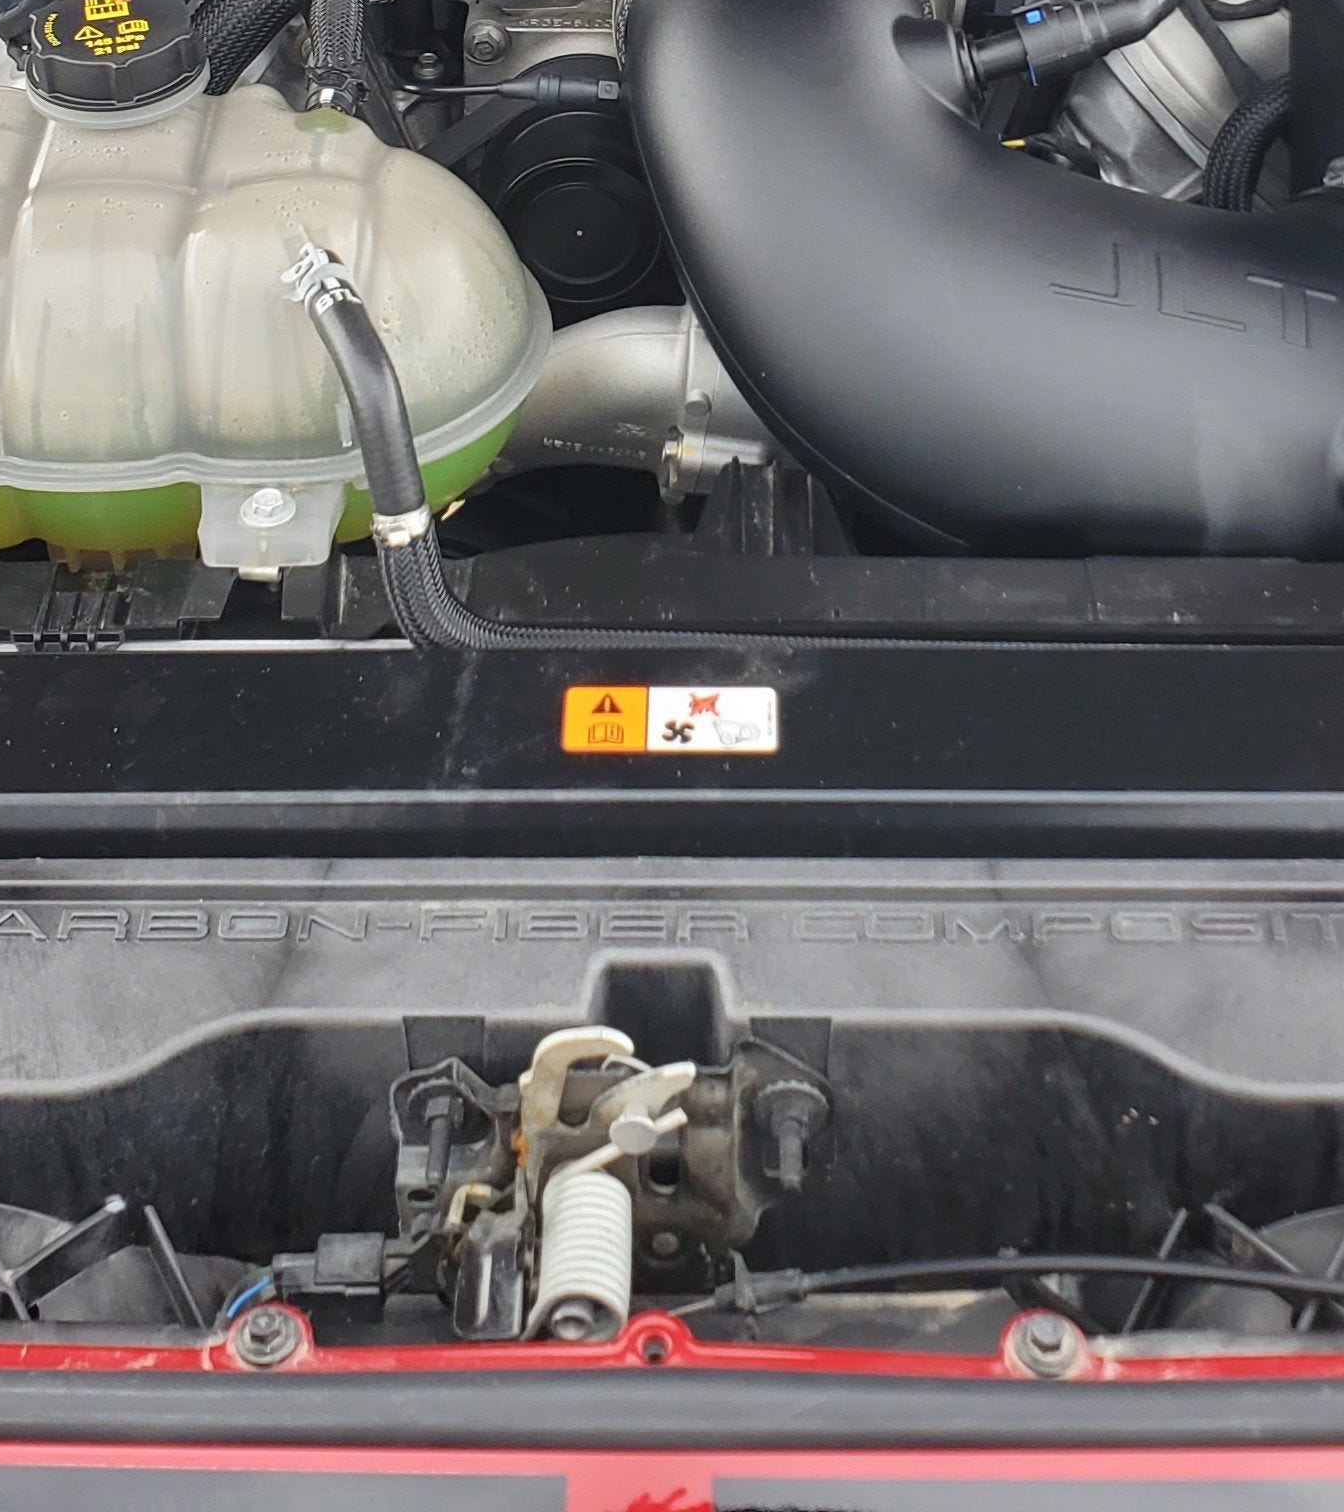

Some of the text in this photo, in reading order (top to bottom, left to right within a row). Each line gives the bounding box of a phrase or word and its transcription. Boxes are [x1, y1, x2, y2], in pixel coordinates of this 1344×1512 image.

[85, 33, 146, 48] 145 kPa
[93, 42, 141, 56] 21 psi
[1050, 242, 1338, 349] JLT
